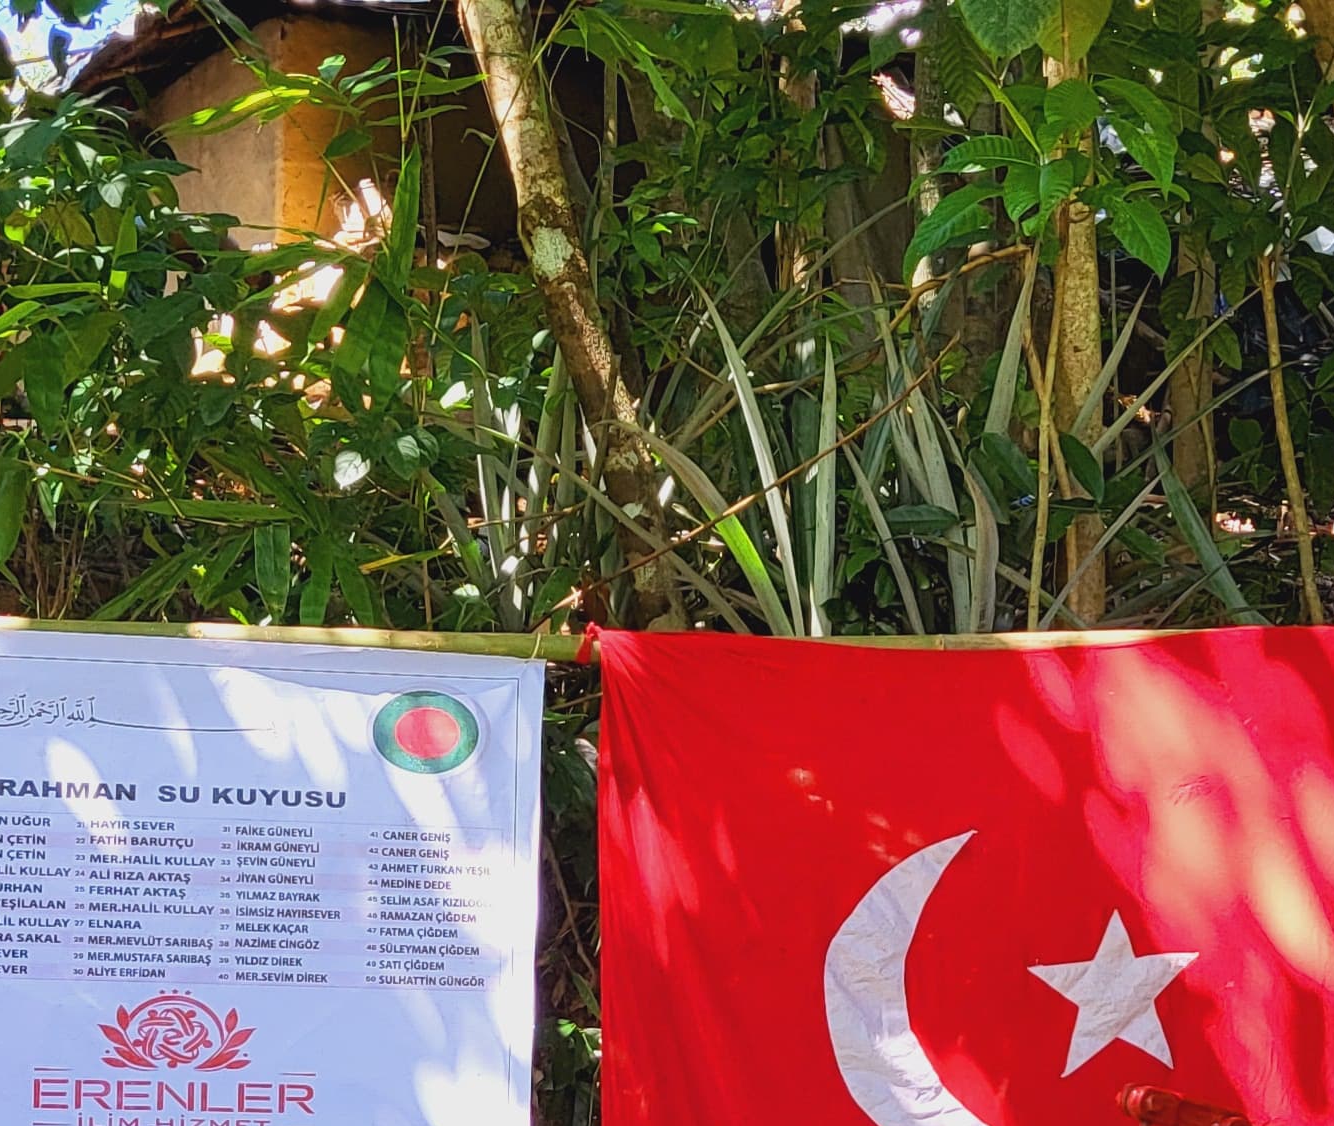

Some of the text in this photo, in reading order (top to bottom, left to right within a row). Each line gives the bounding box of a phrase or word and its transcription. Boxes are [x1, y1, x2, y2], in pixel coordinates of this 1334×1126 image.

[157, 784, 201, 804] SU
[212, 787, 347, 809] KUYUSU
[12, 815, 51, 827] UĞUR
[91, 820, 175, 831] HAYIR SEVER
[236, 826, 313, 837] FAİKE GÜNEYLİ
[383, 831, 451, 843] CANER GENİŞ
[7, 834, 46, 846] ÇETİN
[90, 835, 194, 849] FATİH BARUTÇU
[237, 840, 319, 853] İKRAM GÜNEYLİ
[7, 849, 46, 861] ÇETİN
[382, 848, 449, 860] CANER GENİŞ
[90, 854, 215, 867] MER.HALİL KULLAY
[237, 856, 315, 868] ŞEVİN GÜNEYLİ
[20, 866, 71, 877] KULLAY
[381, 864, 418, 873] AHMET
[421, 865, 462, 874] FURKAN
[90, 869, 191, 884] ALİ RIZA AKTAŞ
[236, 872, 313, 885] JİYAN GÜNEYLİ
[381, 879, 451, 889] MEDİNE DEDE
[89, 886, 186, 899] FERHAT AKTAŞ
[236, 891, 320, 902] YILMAZ BAYRAK
[381, 895, 410, 905] SELİM
[413, 897, 440, 906] ASAF
[89, 902, 214, 915] MER.HALİL KULLAY
[236, 906, 340, 919] İSİMSİZ HAYIRSEVER
[19, 918, 70, 927] KULLAY
[380, 912, 476, 924] RAMAZAN ÇİĞDEM
[89, 920, 142, 929] ELNARA
[236, 923, 309, 936] MELEK KAÇAR
[17, 934, 61, 943] SAKAL
[380, 928, 458, 939] FATMA ÇİĞDEM
[88, 936, 213, 950] MER.MEVLÜT SARIBAŞ
[235, 937, 320, 949] NAZİME CİNGÖZ
[379, 943, 479, 957] SÜLEYMAN ÇİĞDEM
[88, 952, 211, 966] MER.MUSTAFA SARIBAŞ
[235, 956, 302, 966] YILDIZ DİREK
[87, 966, 117, 977] ALİYE
[120, 967, 165, 978] ERFİDAN
[379, 961, 444, 971] SATI ÇİĞDEM
[236, 972, 328, 983] MER.SEVİM DİREK
[379, 974, 484, 987] SULHATTİN GÜNGÖR
[33, 1078, 315, 1114] ERENLER
